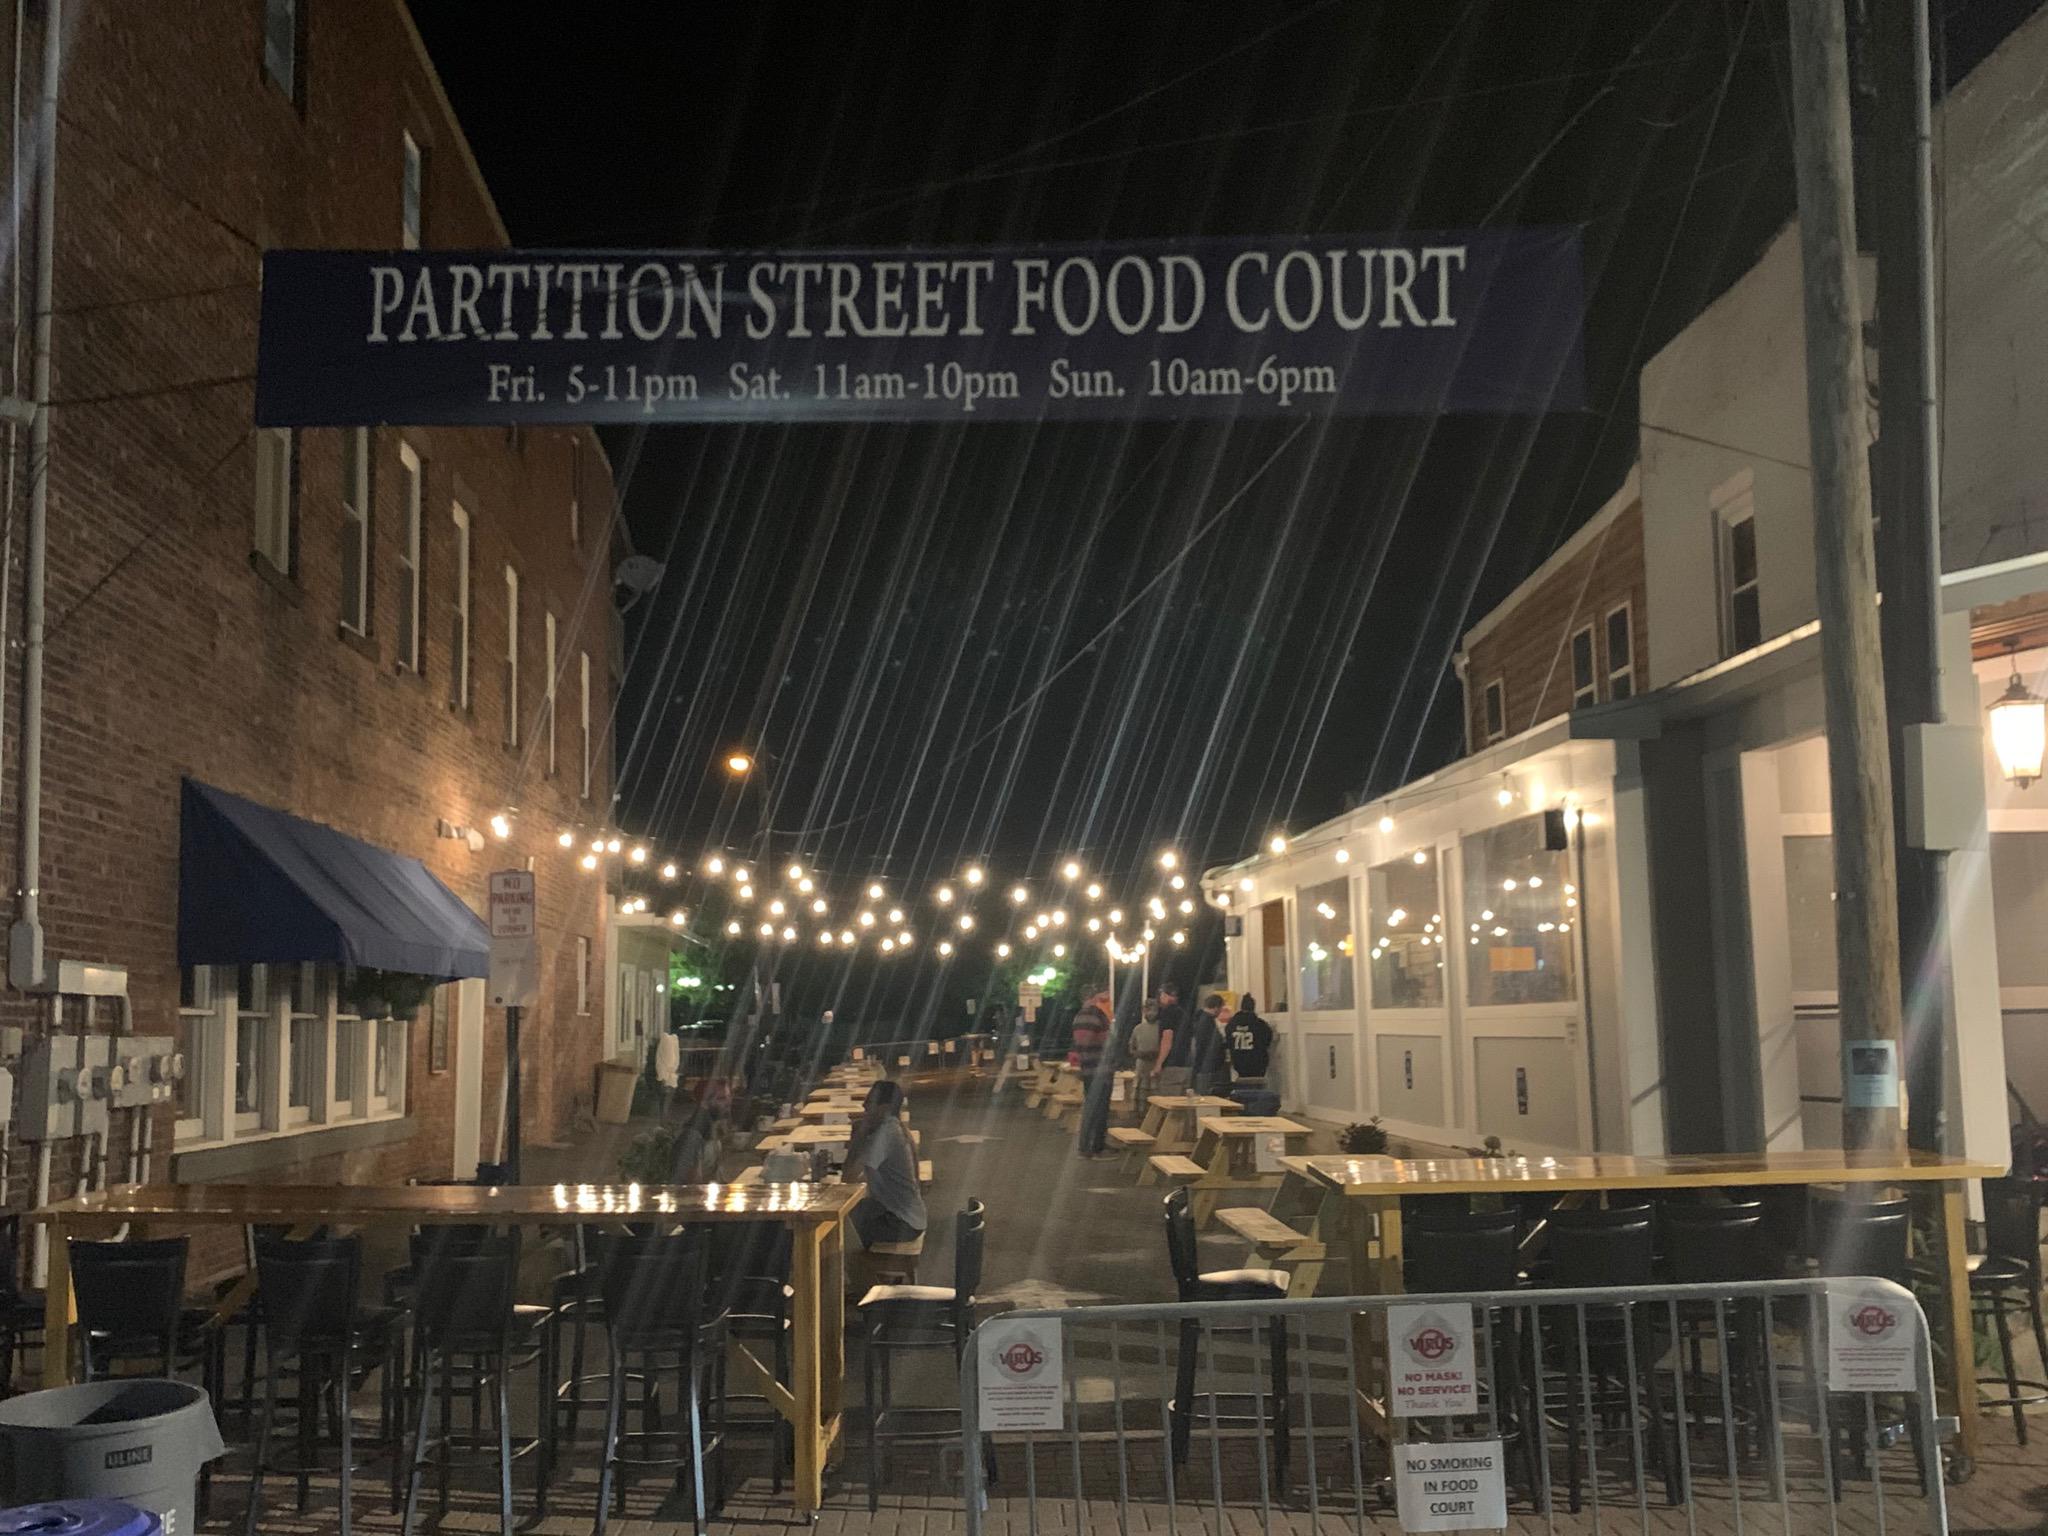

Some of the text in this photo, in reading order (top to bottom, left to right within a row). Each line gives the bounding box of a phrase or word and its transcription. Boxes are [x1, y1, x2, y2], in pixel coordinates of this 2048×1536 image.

[366, 245, 1468, 342] PARTITION STREET FOOD COURT
[487, 353, 1337, 414] Fri. 5-11pm Sat. 11am-10pm Sun. 10am-6pm
[1405, 1373, 1422, 1382] NO
[1397, 1387, 1415, 1396] NO
[106, 1447, 152, 1468] ULINE
[1407, 1456, 1493, 1471] NO SMOKING
[1424, 1479, 1479, 1492] IN FOOD
[1430, 1501, 1475, 1513] COURT
